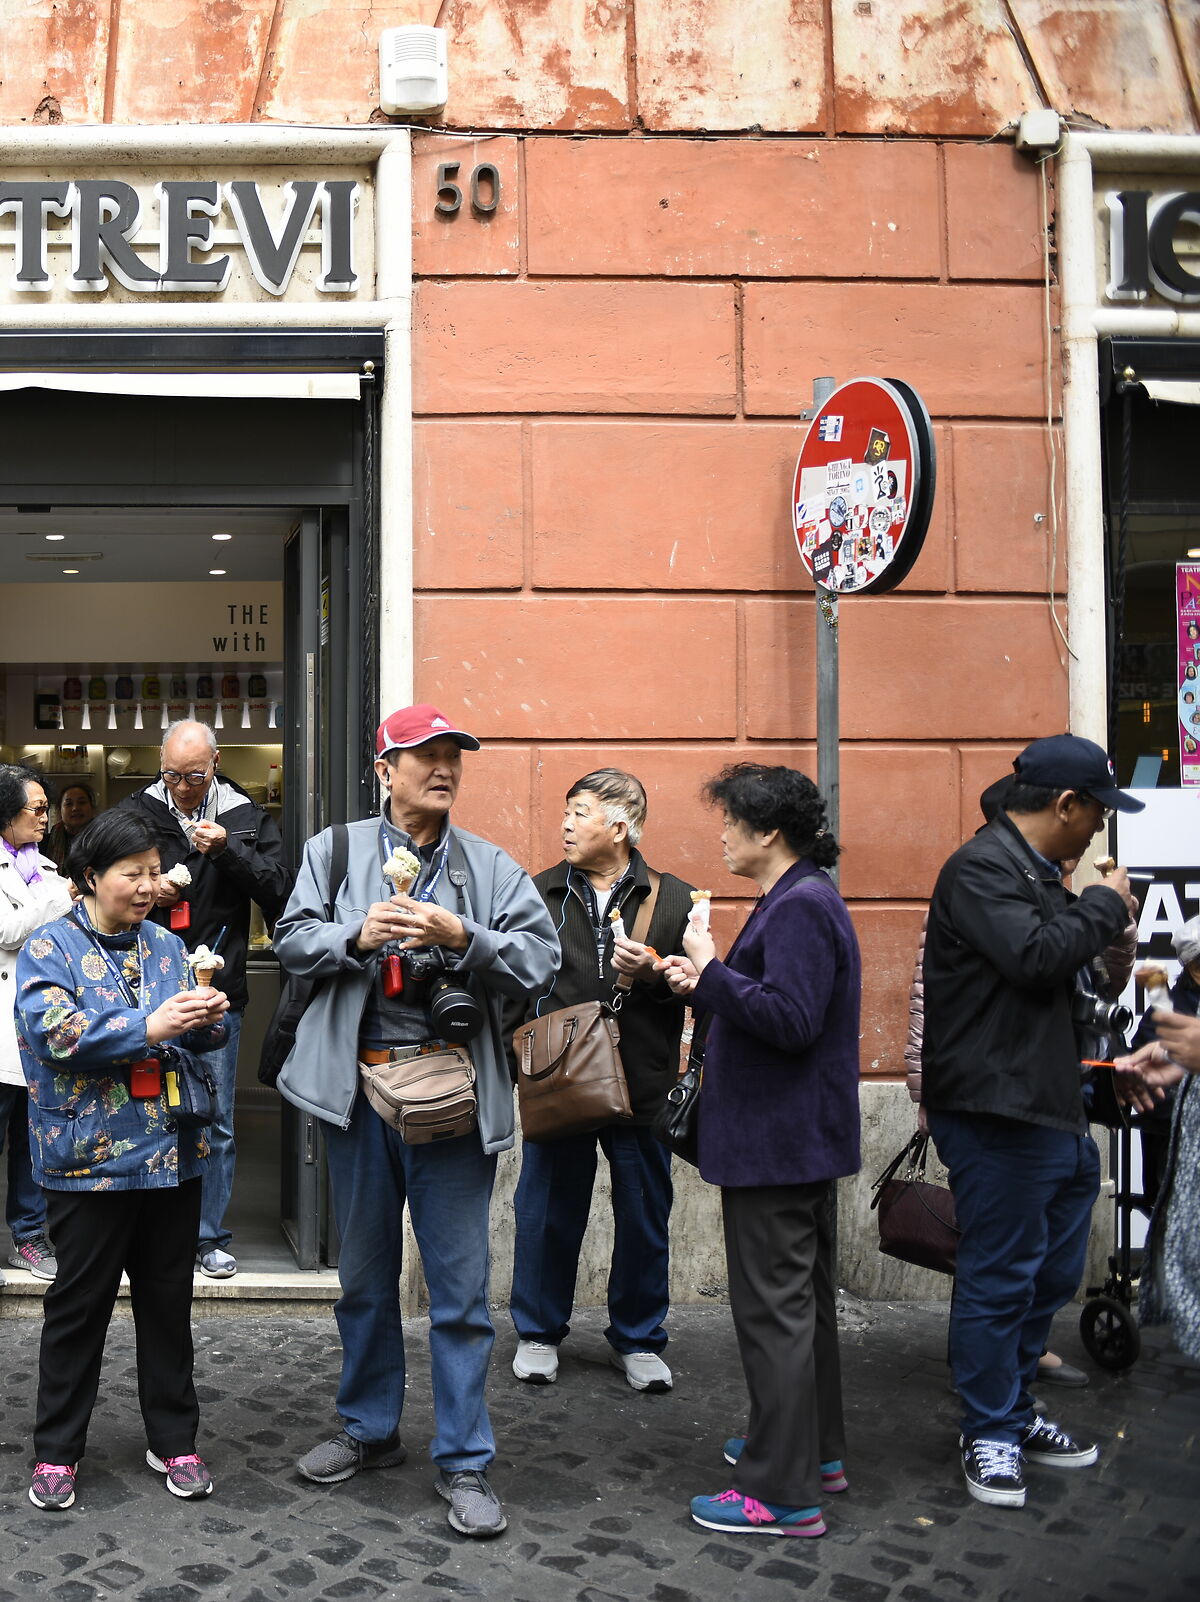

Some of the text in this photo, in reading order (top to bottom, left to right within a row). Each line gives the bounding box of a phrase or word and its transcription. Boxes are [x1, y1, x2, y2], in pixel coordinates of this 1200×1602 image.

[435, 161, 500, 213] 50
[227, 604, 268, 625] THE
[212, 631, 265, 652] with
